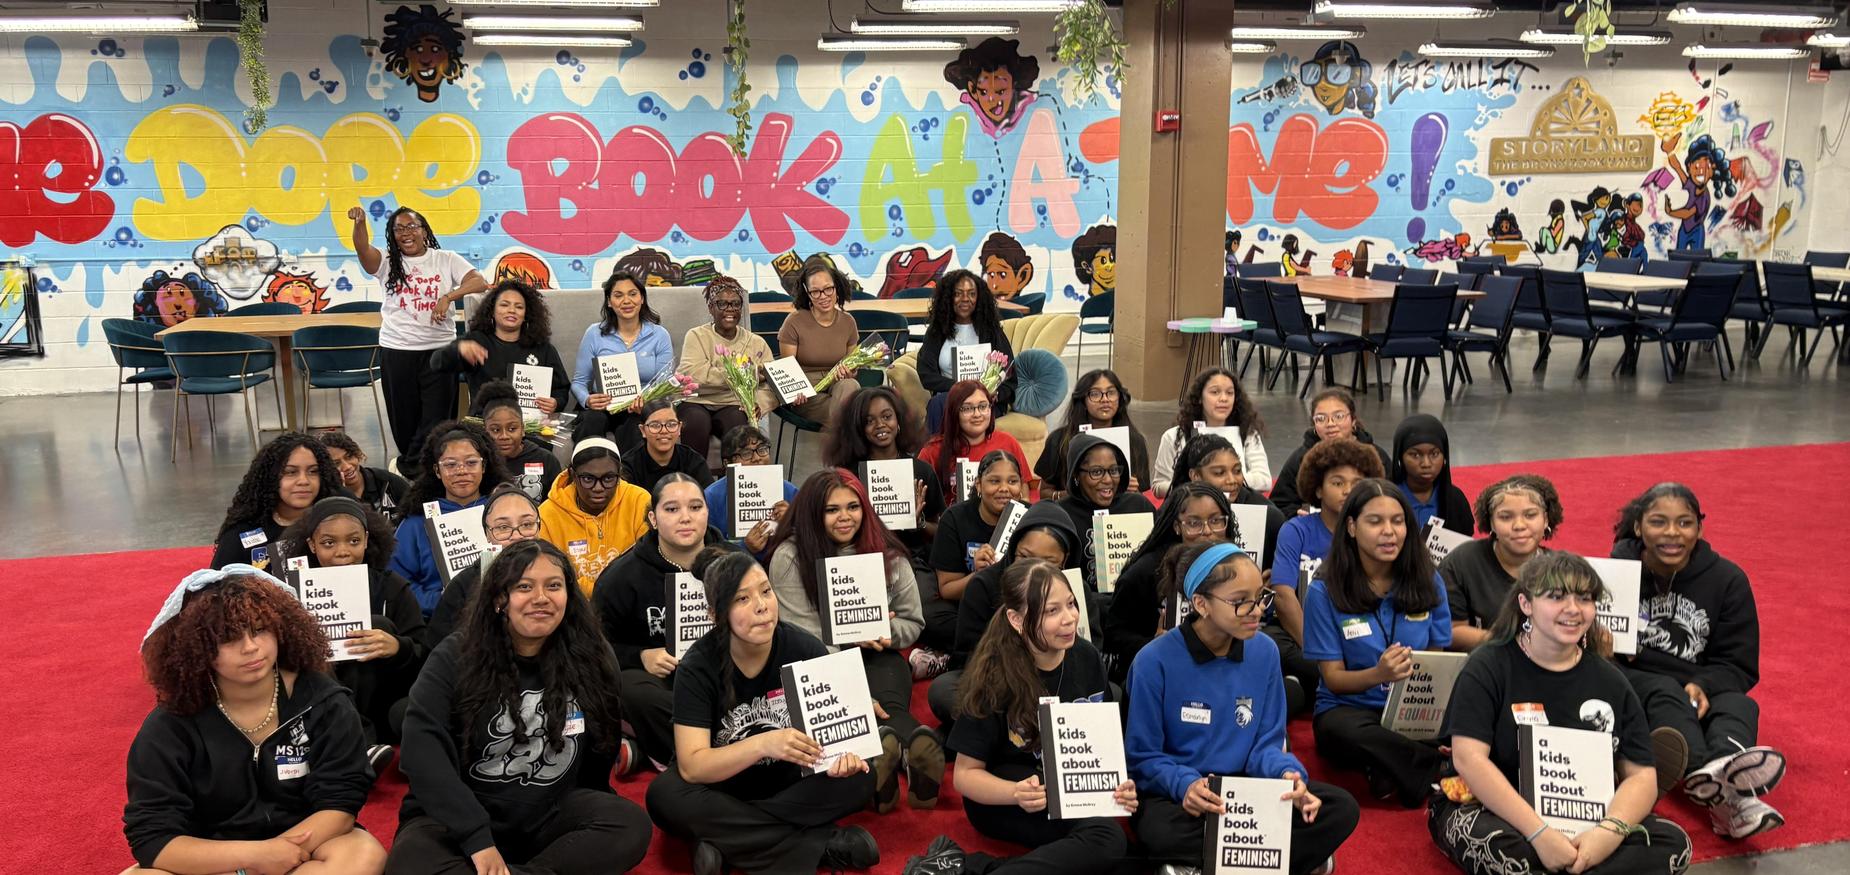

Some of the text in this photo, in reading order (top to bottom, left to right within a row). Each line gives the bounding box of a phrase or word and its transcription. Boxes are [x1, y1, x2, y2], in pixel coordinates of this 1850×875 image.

[1503, 138, 1643, 156] STORYLAND
[1493, 159, 1518, 170] THE
[515, 375, 532, 384] kids
[604, 373, 622, 381] book
[774, 374, 790, 382] book
[778, 378, 796, 387] about
[515, 383, 533, 391] book
[605, 380, 626, 388] about
[782, 381, 807, 393] FEMINISM
[519, 390, 536, 398] bout
[608, 387, 636, 397] FEMINISM
[871, 476, 890, 484] kids
[872, 494, 898, 502] about
[738, 500, 766, 508] about
[875, 502, 910, 514] FEMINISM
[441, 528, 463, 542] kids
[1107, 531, 1127, 540] kids
[444, 534, 470, 548] book
[1108, 541, 1131, 550] book
[447, 543, 477, 557] about
[1429, 542, 1449, 554] kids
[305, 579, 313, 587] a
[831, 576, 855, 585] kids
[305, 588, 333, 599] kids
[680, 591, 704, 600] kids
[832, 586, 860, 597] book
[307, 599, 339, 611] book
[680, 603, 707, 612] book
[833, 597, 866, 608] about
[836, 607, 880, 624] FEMINISM
[800, 675, 809, 683] a
[1409, 672, 1433, 681] kids
[803, 682, 831, 698] kids
[1406, 682, 1433, 694] book
[805, 694, 840, 712] book
[1402, 696, 1435, 706] about
[809, 706, 848, 726] about
[1057, 716, 1065, 725] a
[815, 716, 869, 744] FEMINISM
[1058, 728, 1087, 740] kids
[1539, 739, 1548, 747] a
[276, 745, 297, 756] MS
[1060, 743, 1093, 755] book
[1061, 757, 1101, 769] about
[1540, 751, 1571, 765] kids
[1540, 766, 1577, 781] book
[1065, 774, 1119, 791] FEMINISM
[1226, 791, 1235, 799] a
[1540, 782, 1585, 797] about
[1225, 803, 1255, 815] kids
[1543, 798, 1602, 821] FEMINISM
[1224, 818, 1258, 830] book
[1223, 832, 1264, 844] about
[1225, 849, 1279, 867] FEMINISM
